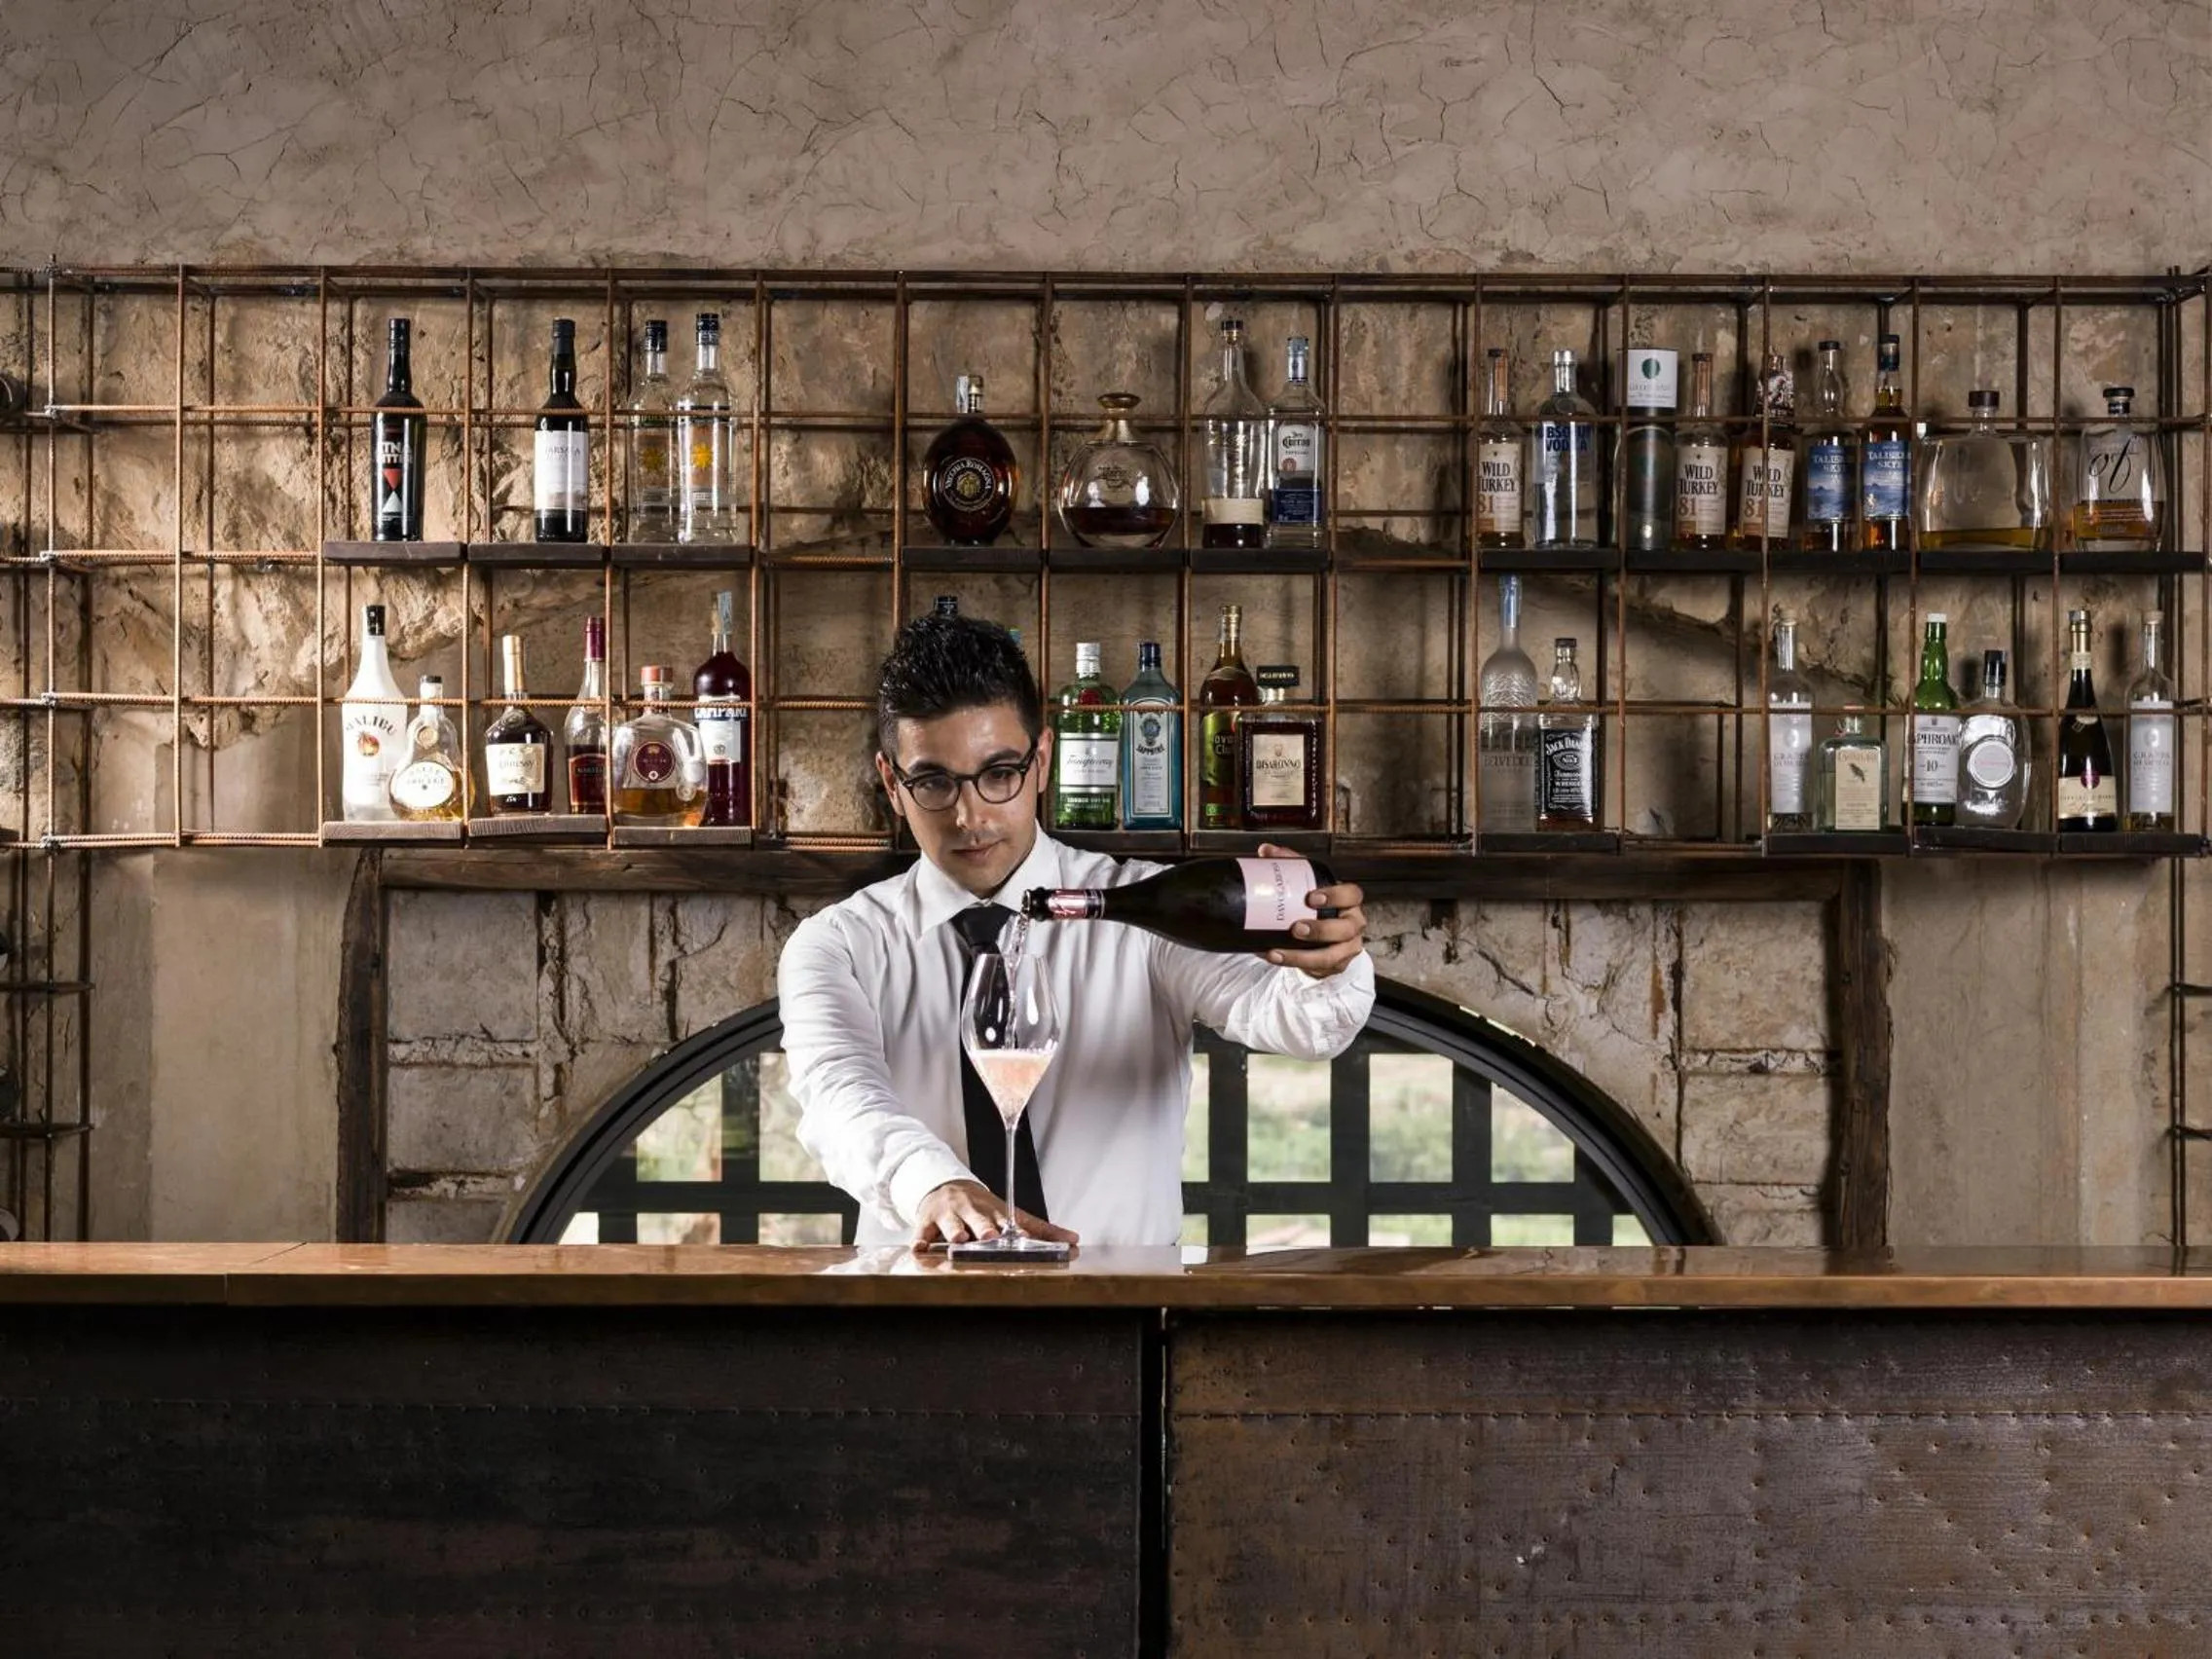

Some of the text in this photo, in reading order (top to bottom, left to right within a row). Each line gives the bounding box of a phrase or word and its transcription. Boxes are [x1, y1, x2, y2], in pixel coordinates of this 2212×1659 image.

[1535, 425, 1594, 438] ABSOUT
[1546, 439, 1588, 452] VODA
[1482, 461, 1511, 476] WILD
[1685, 464, 1714, 479] WILD
[1753, 465, 1781, 482] WLD
[1478, 477, 1516, 492] TURKEY
[1679, 479, 1718, 495] TURKEY
[1478, 495, 1493, 513] 81
[1677, 498, 1696, 516] 81
[1744, 498, 1763, 518] 81
[346, 715, 397, 736] MALIBU
[1545, 740, 1564, 756] JACK
[1255, 759, 1302, 769] DISARONNO
[1927, 760, 1937, 771] 10
